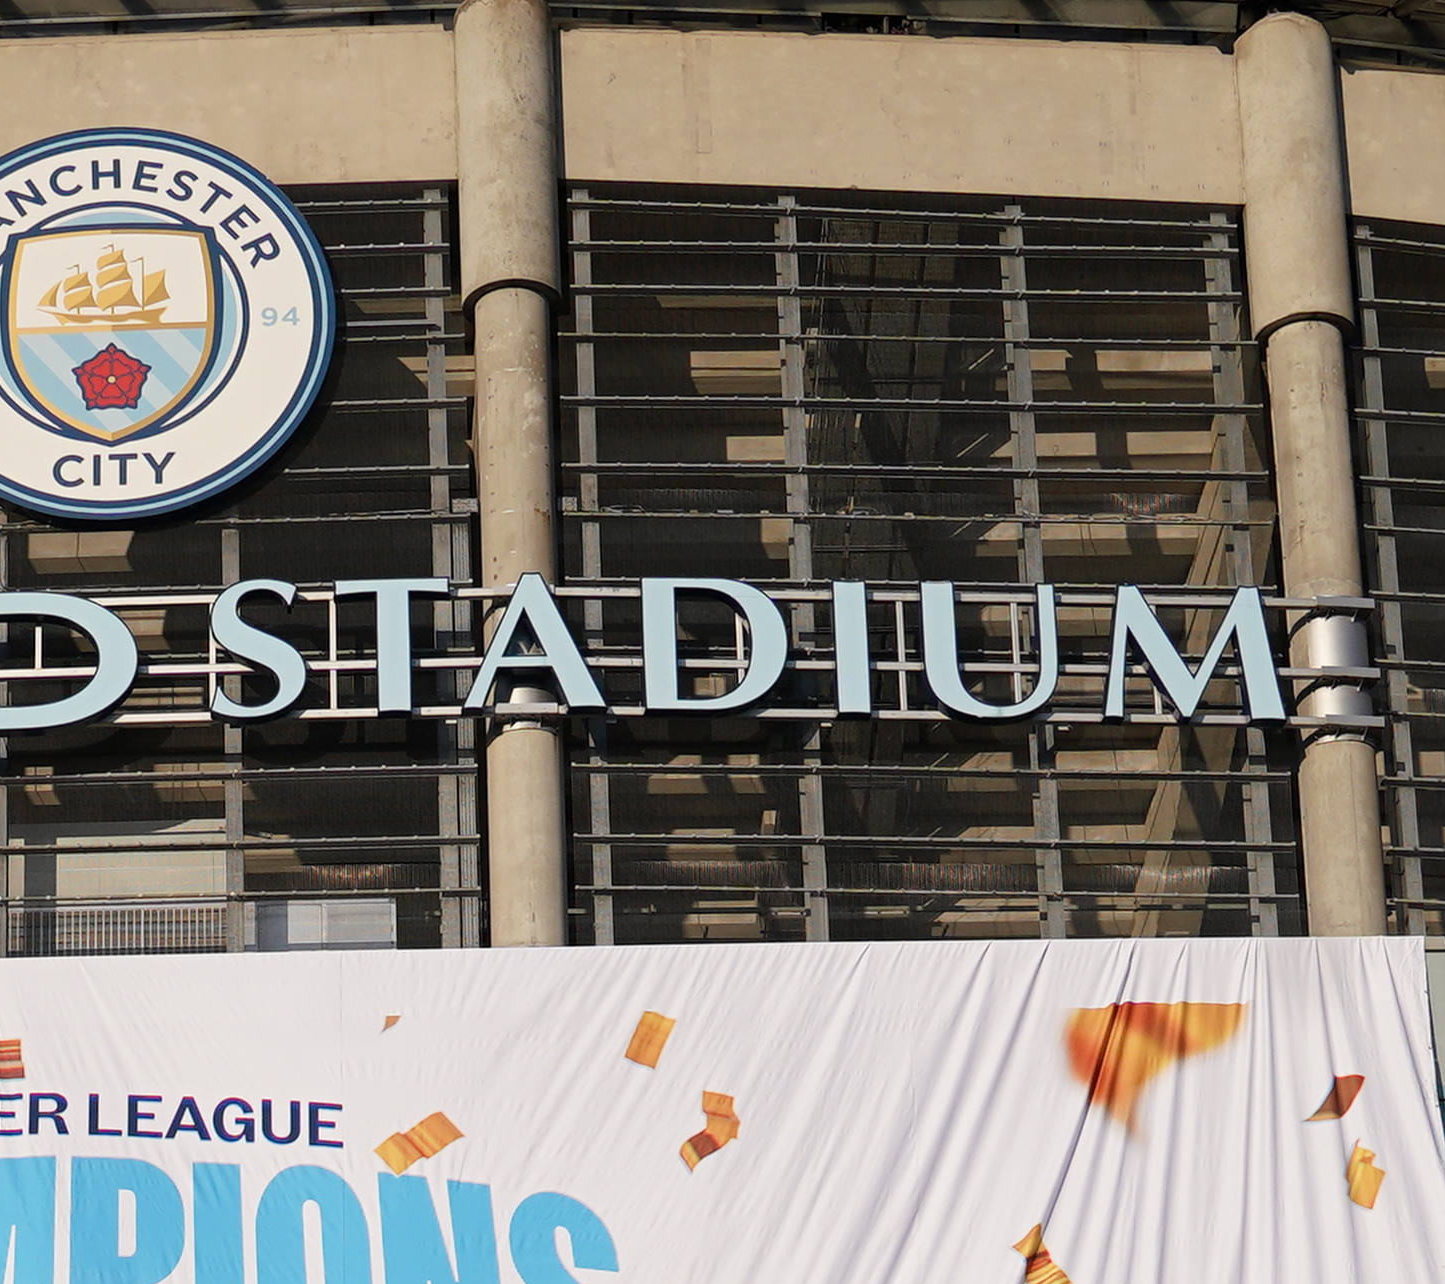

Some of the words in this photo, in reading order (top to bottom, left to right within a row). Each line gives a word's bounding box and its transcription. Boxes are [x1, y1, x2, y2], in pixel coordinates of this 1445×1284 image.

[261, 306, 300, 327] 94
[53, 452, 175, 487] CITY
[209, 572, 1288, 724] STADIUM
[86, 1093, 344, 1151] LEAGUE
